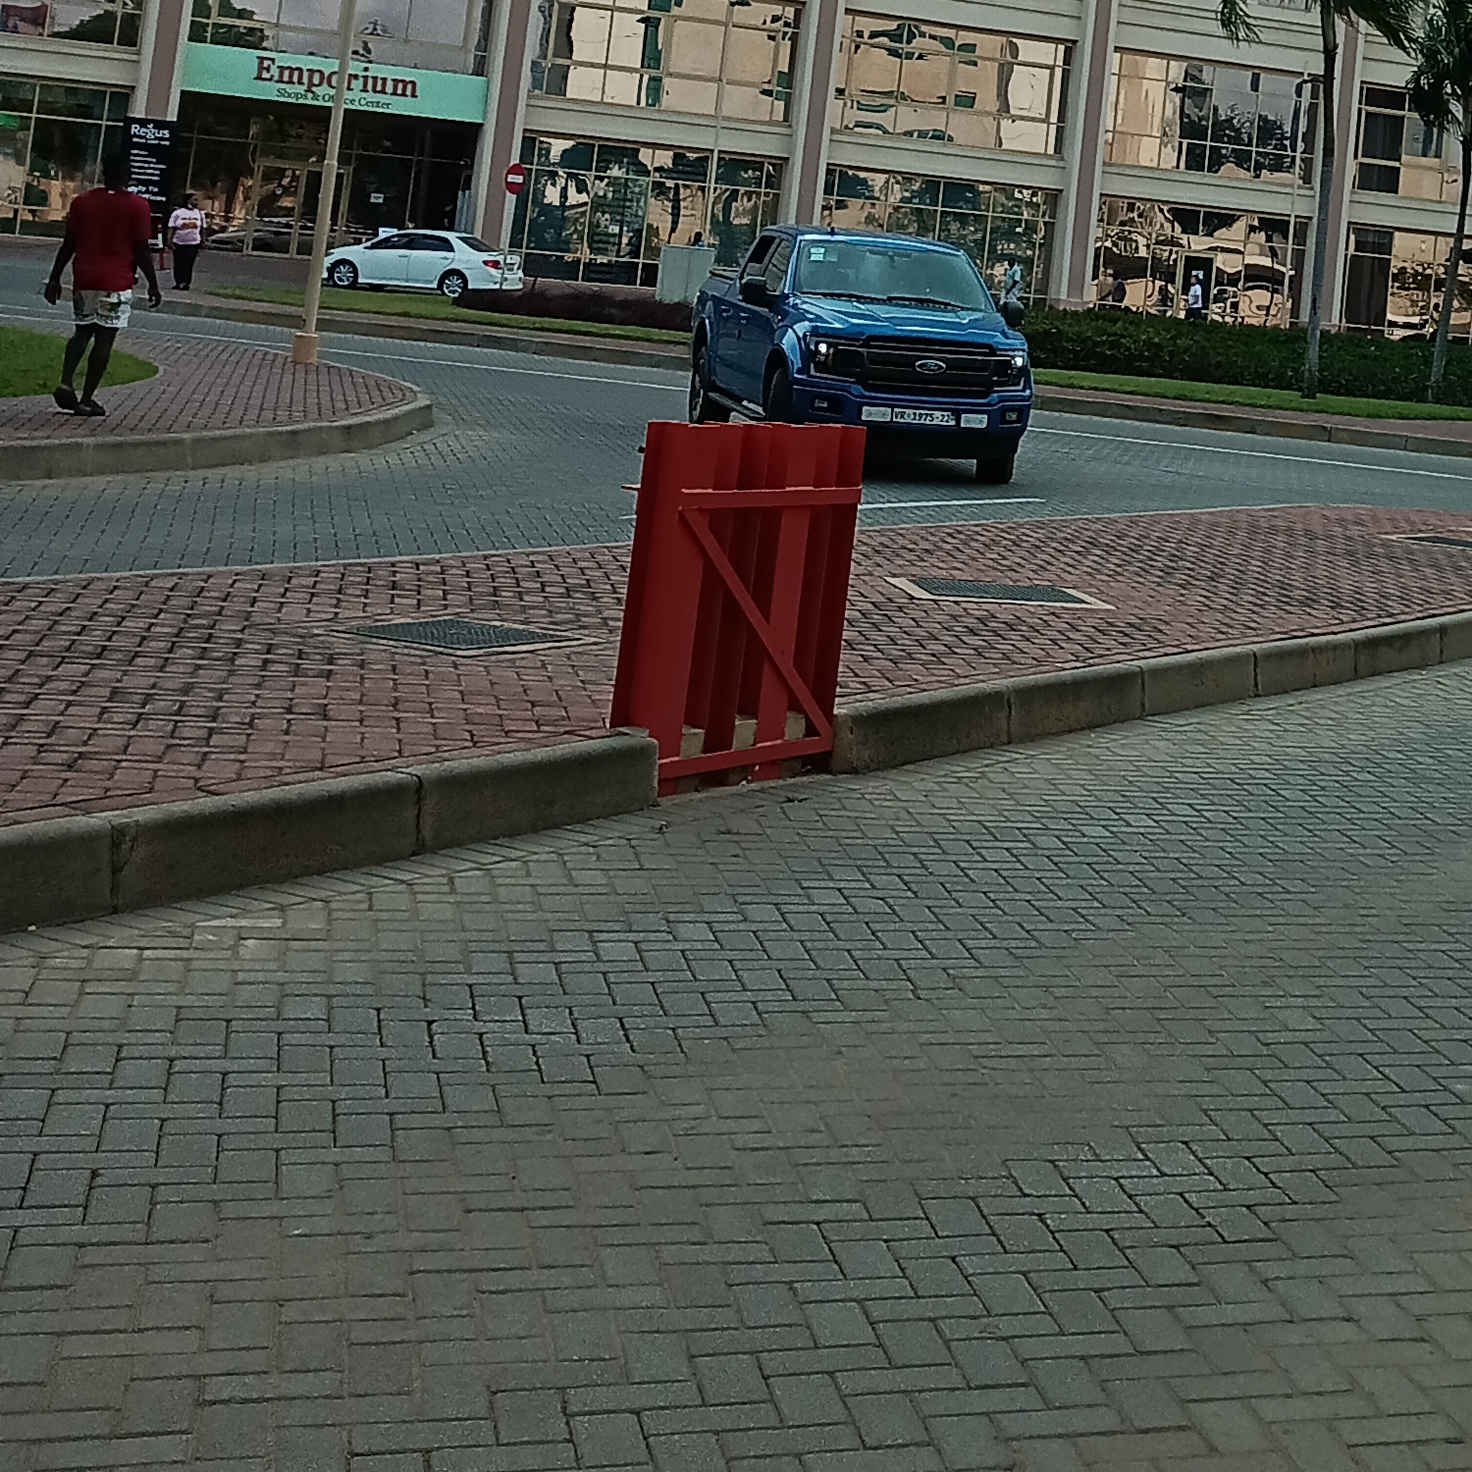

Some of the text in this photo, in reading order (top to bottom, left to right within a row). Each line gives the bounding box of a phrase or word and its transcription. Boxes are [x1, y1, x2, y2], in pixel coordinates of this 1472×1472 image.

[253, 56, 418, 98] Emporium
[276, 87, 392, 110] Shops & Ofce Center
[130, 123, 170, 139] Regus
[894, 410, 906, 421] VR
